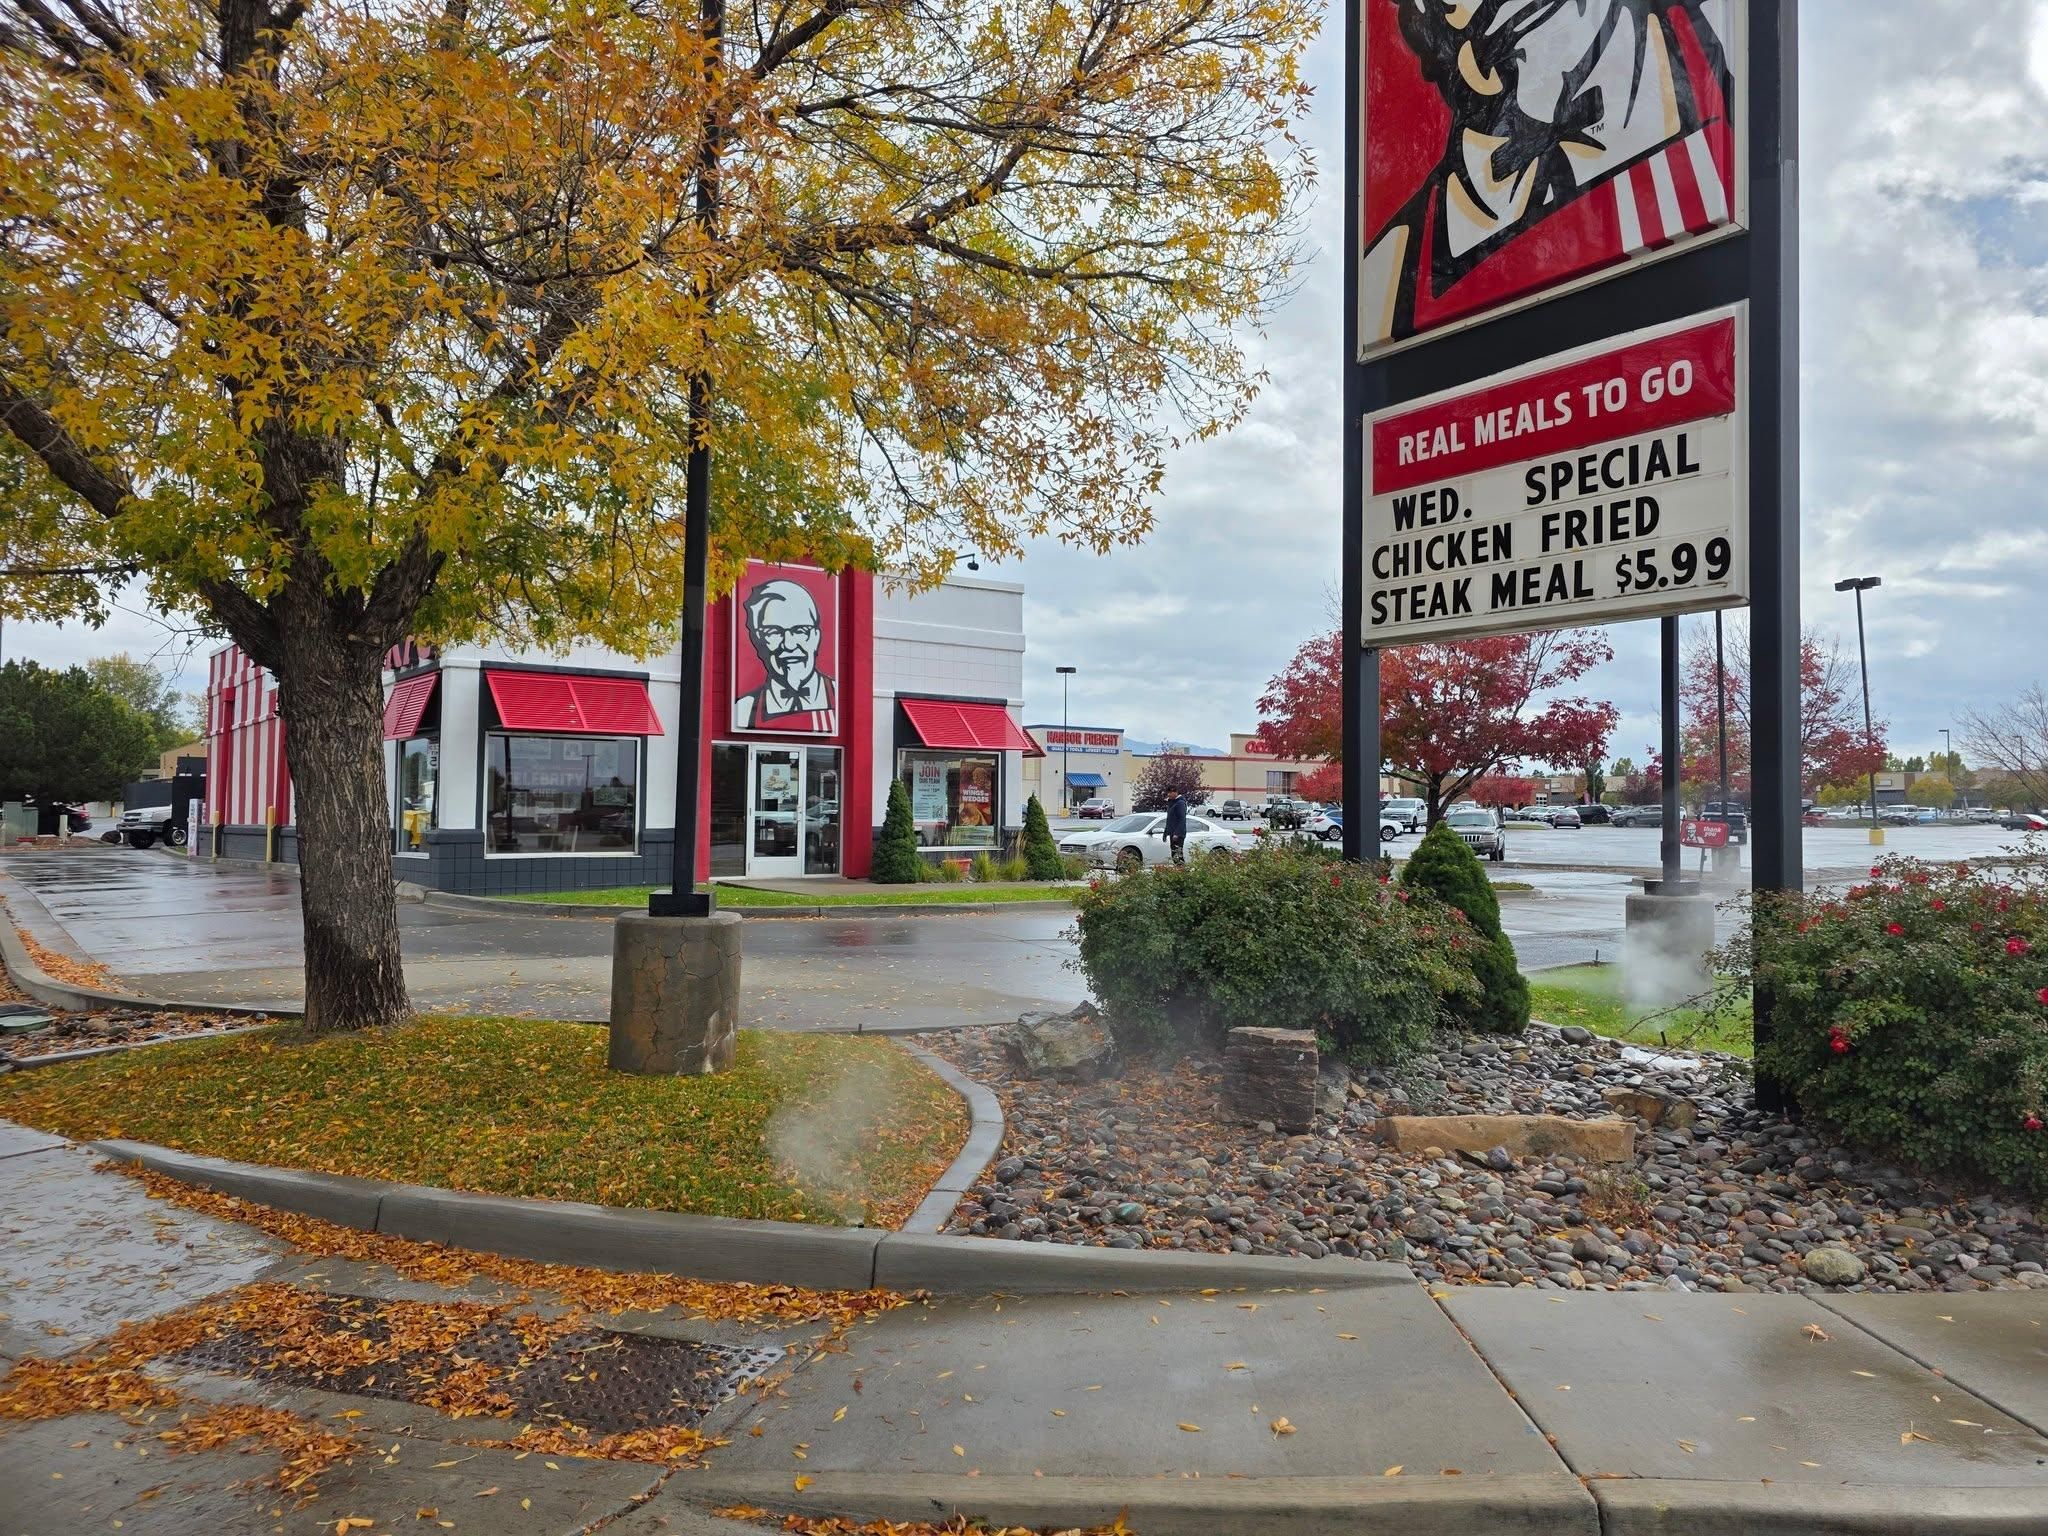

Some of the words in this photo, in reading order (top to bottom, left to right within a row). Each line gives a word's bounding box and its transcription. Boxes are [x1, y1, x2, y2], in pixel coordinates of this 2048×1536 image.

[1590, 123, 1604, 135] TM
[1399, 427, 1465, 466] REAL
[1474, 391, 1573, 447] MEALS
[1582, 377, 1627, 417] TO
[1640, 359, 1694, 403] GO
[1392, 487, 1473, 532] WED.
[1525, 433, 1700, 506] SPECIAL
[1371, 522, 1512, 580] CHICKEN
[1541, 495, 1660, 553] FRIED
[1371, 577, 1473, 625] STEAK
[1491, 559, 1594, 610] MEAL
[1615, 536, 1732, 594] $5.99
[919, 766, 940, 777] JOIN
[1047, 731, 1081, 744] HARBOR
[1084, 733, 1119, 746] FREIGHT
